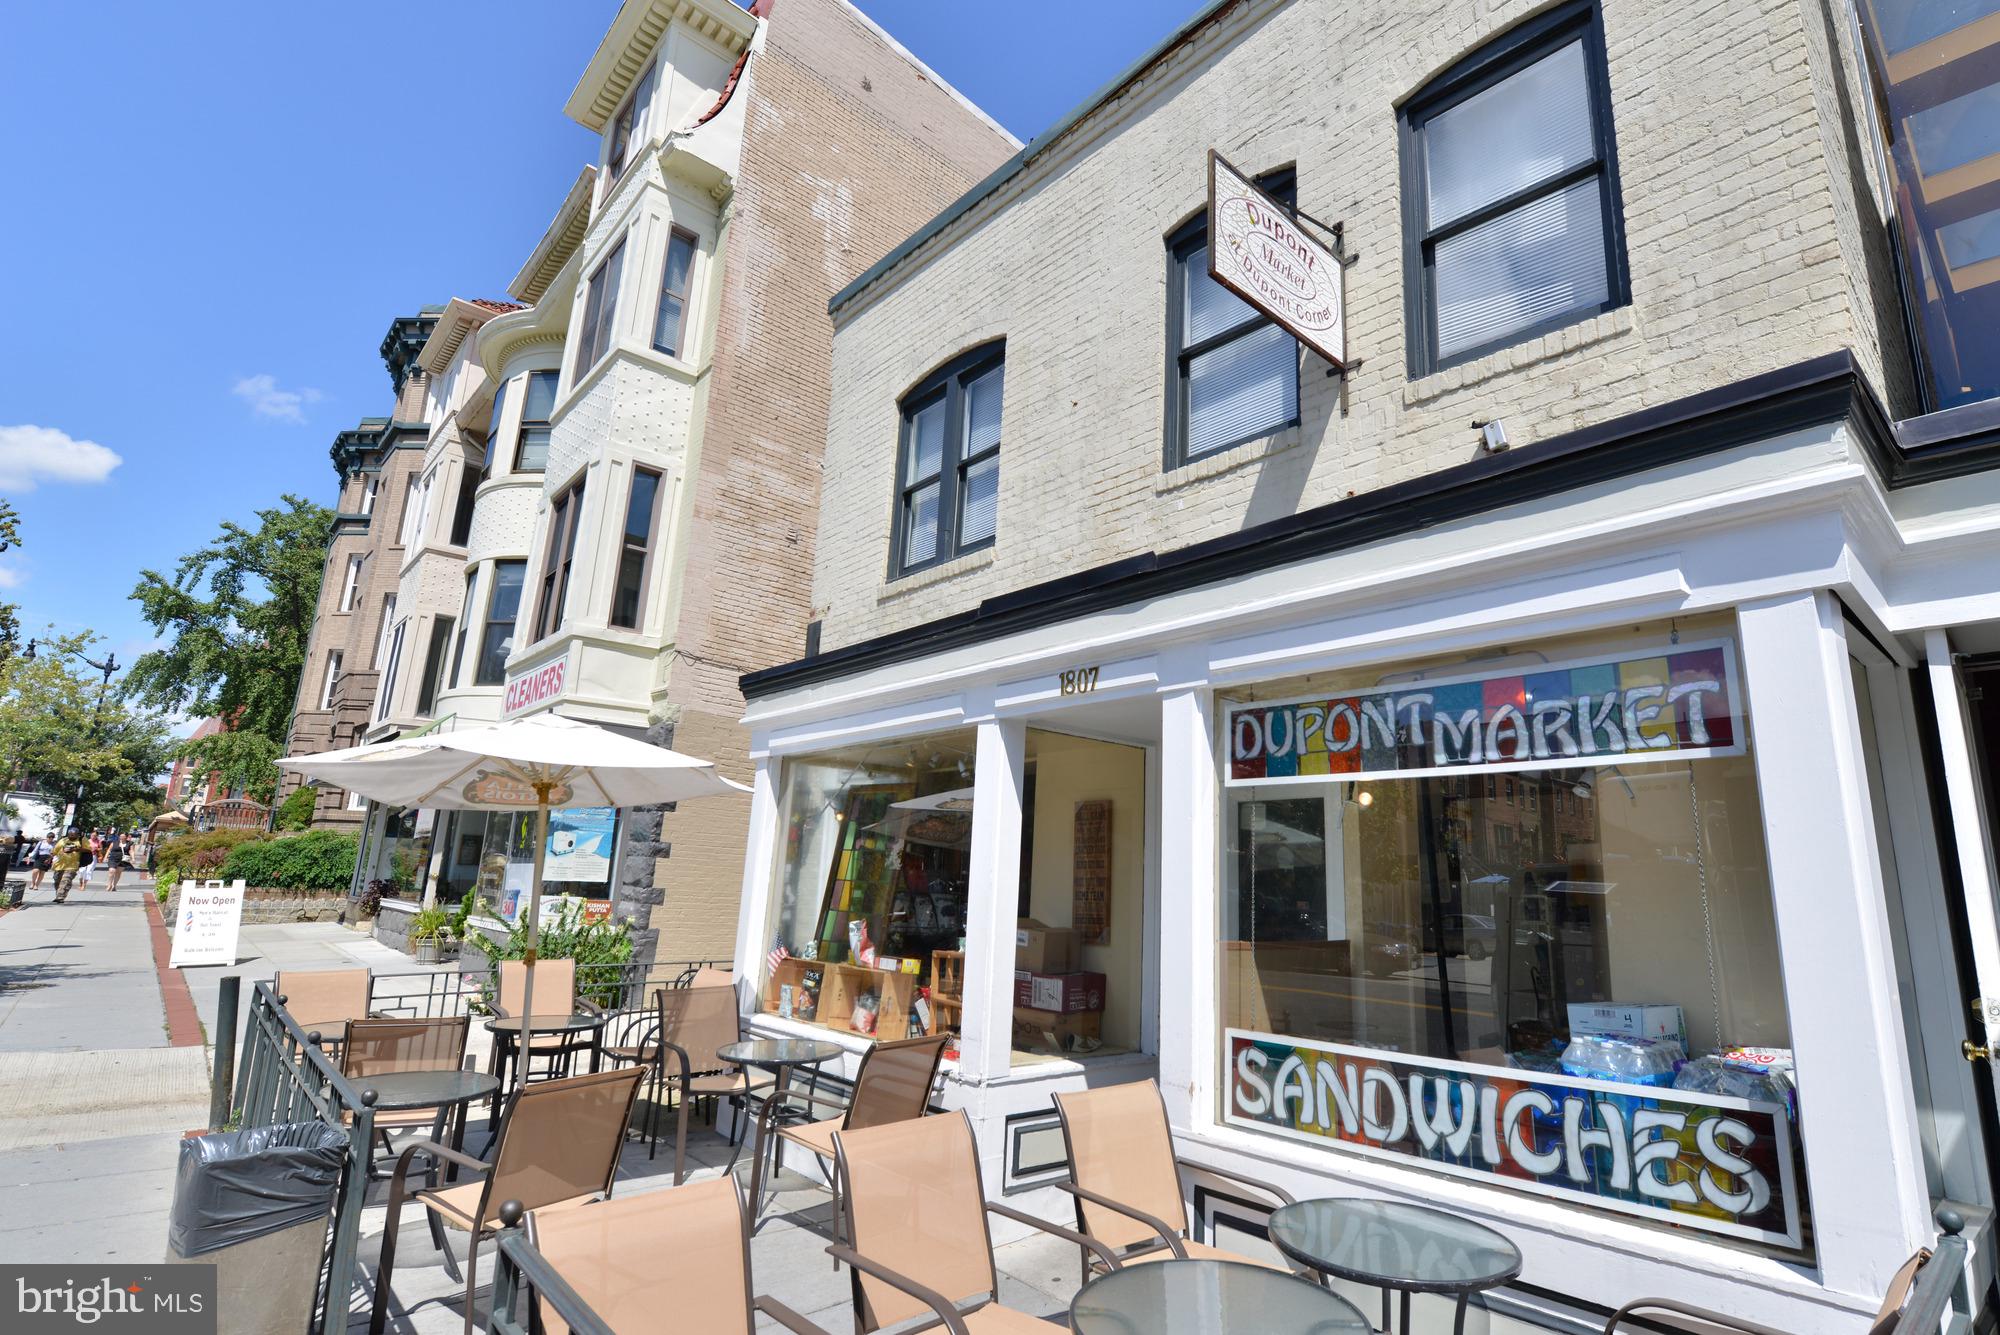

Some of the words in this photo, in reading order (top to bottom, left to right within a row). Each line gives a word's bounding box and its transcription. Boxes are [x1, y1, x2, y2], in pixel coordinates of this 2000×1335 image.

[1246, 201, 1315, 271] Dupont
[1243, 255, 1291, 312] Dupont
[1296, 304, 1332, 325] Corner
[1259, 243, 1306, 291] Market
[506, 662, 564, 713] CLEANERS
[1059, 666, 1099, 696] 1807
[1235, 693, 1434, 761] DUPONT
[1433, 680, 1720, 766] MARKET
[188, 896, 209, 905] Now
[212, 896, 236, 907] Open
[1235, 1047, 1771, 1215] SANDWICHES
